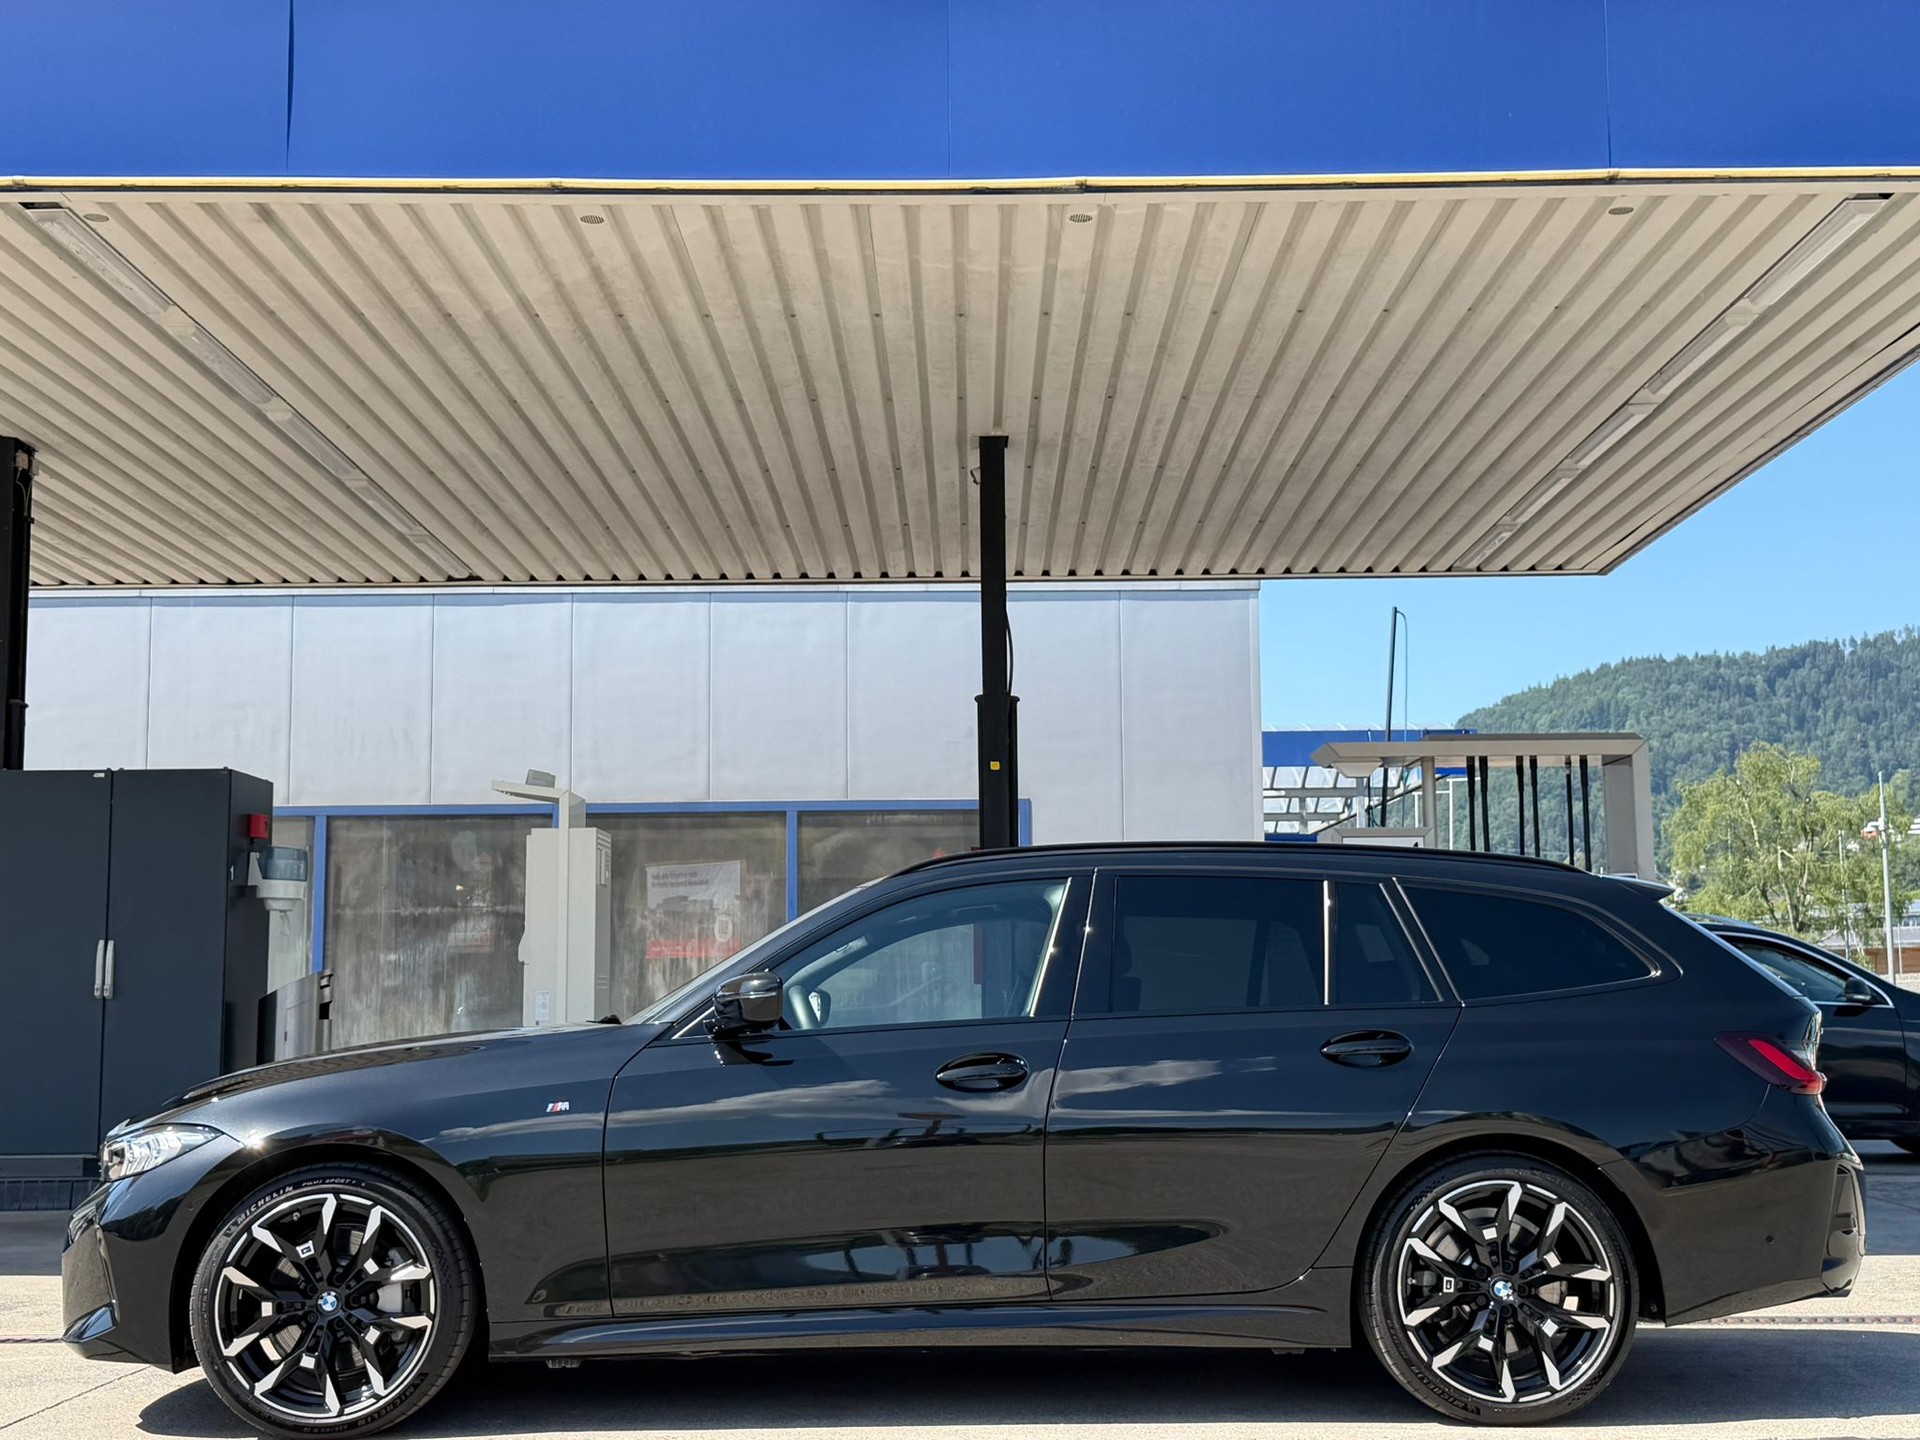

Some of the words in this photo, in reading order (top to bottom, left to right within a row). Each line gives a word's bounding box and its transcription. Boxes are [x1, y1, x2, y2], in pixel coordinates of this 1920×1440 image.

[237, 1185, 294, 1224] MICHELIN
[357, 1385, 415, 1426] MICHELIN
[1410, 1364, 1467, 1409] MICHELIN
